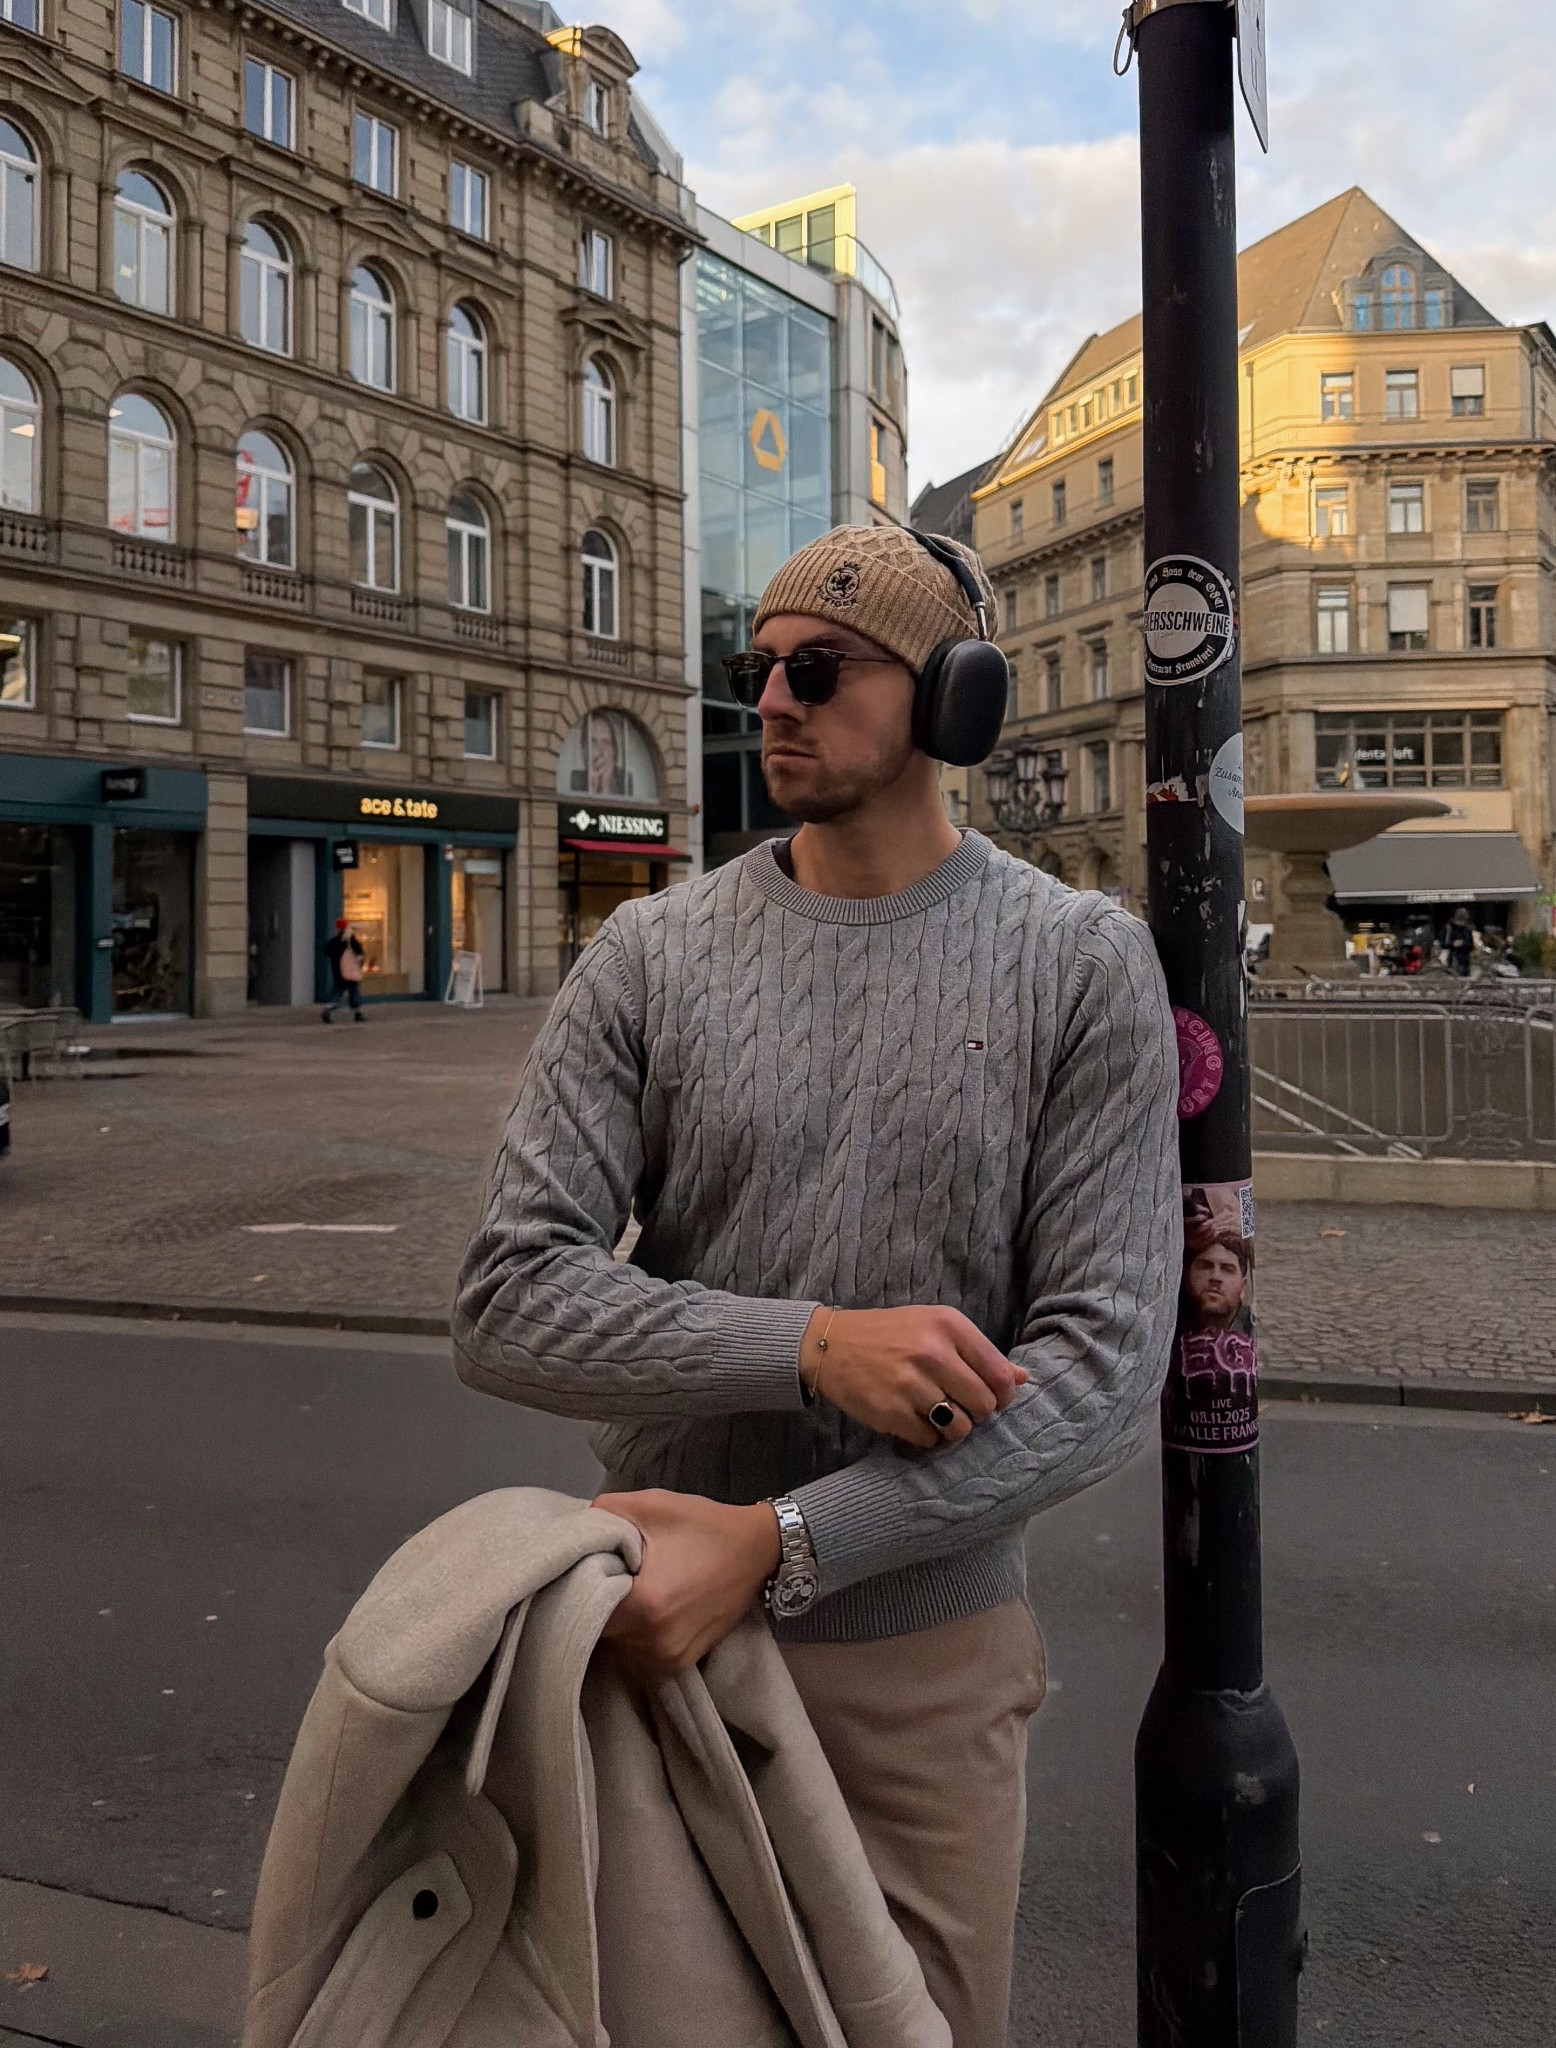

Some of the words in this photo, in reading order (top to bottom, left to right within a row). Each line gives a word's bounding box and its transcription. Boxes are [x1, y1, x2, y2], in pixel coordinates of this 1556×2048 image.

[361, 798, 392, 815] ace
[405, 799, 438, 819] tate
[598, 814, 664, 837] NIESSING
[1211, 1398, 1233, 1409] LIVE
[1190, 1407, 1250, 1425] 08.11.2025
